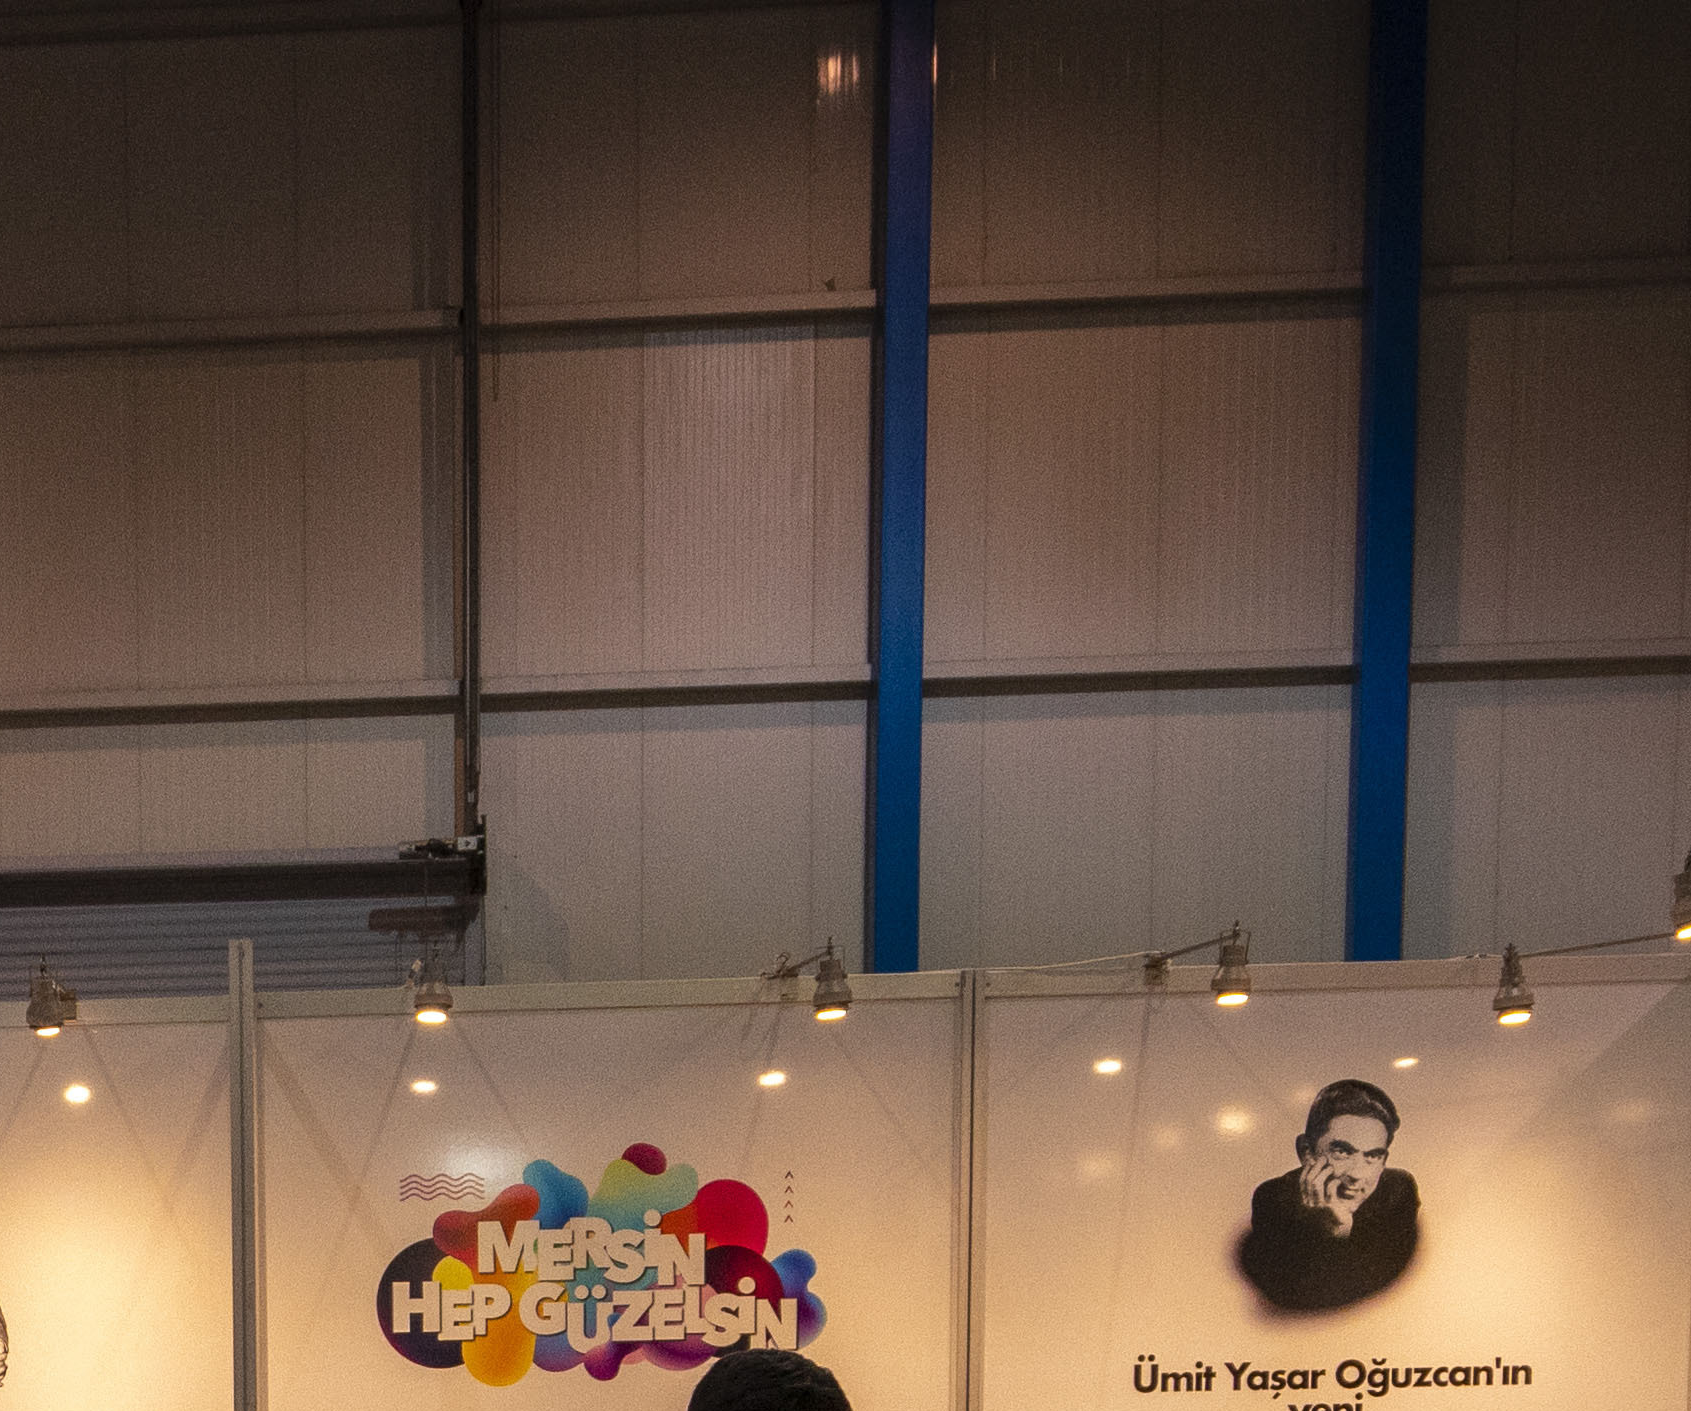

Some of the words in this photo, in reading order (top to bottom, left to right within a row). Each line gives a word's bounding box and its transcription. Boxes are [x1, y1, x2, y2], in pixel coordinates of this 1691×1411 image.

[477, 1209, 706, 1287] MERSİN
[392, 1281, 511, 1343] HEP
[519, 1276, 798, 1352] GÜZELSİN
[1133, 1356, 1217, 1394] Ümit
[1224, 1362, 1327, 1399] Yaşar
[1336, 1358, 1533, 1398] Oğuzcan'ın
